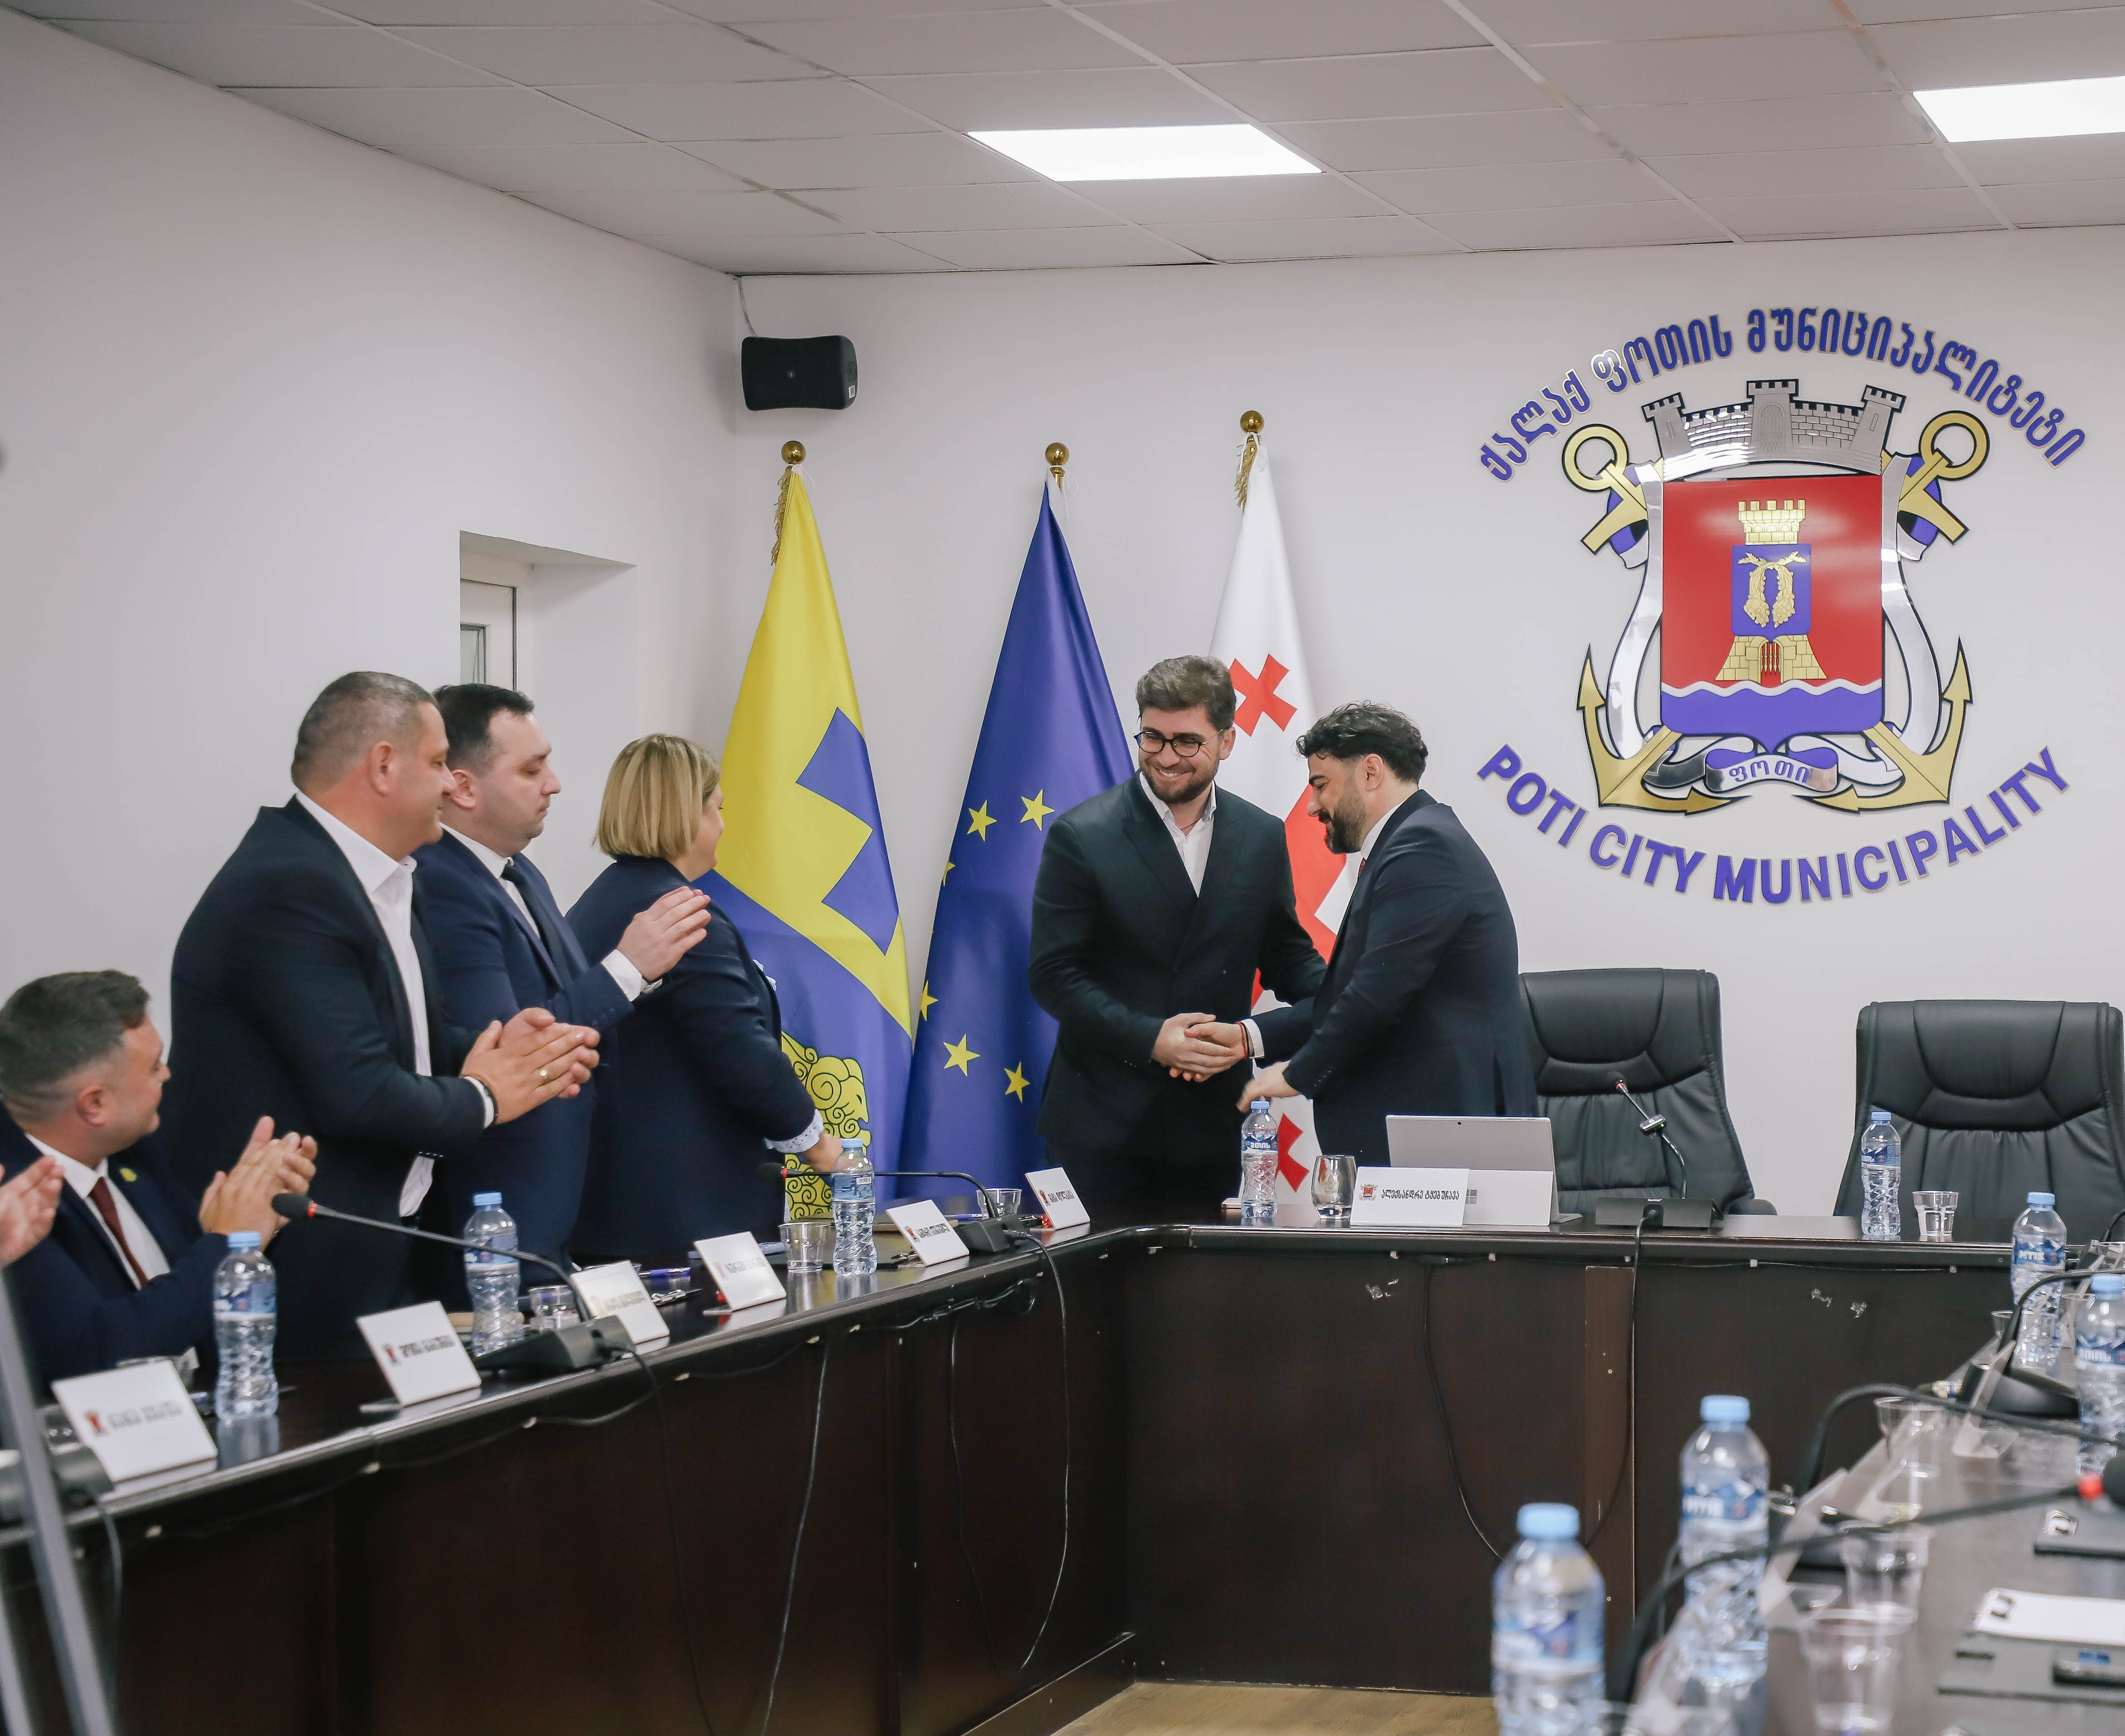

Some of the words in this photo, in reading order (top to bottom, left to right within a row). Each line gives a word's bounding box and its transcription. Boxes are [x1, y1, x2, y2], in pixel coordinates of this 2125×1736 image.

[1480, 370, 1591, 481] ქალაქ
[1591, 314, 1733, 393] ფოთის
[1747, 307, 2086, 468] მუნიციპალიტეტი
[1729, 760, 1809, 783] ფოთი
[1478, 744, 1586, 845] POTI
[1589, 824, 1704, 893] CITY
[1713, 748, 2068, 903] MUNICIPALITY
[1381, 1189, 1424, 1199] ალექსანდრე
